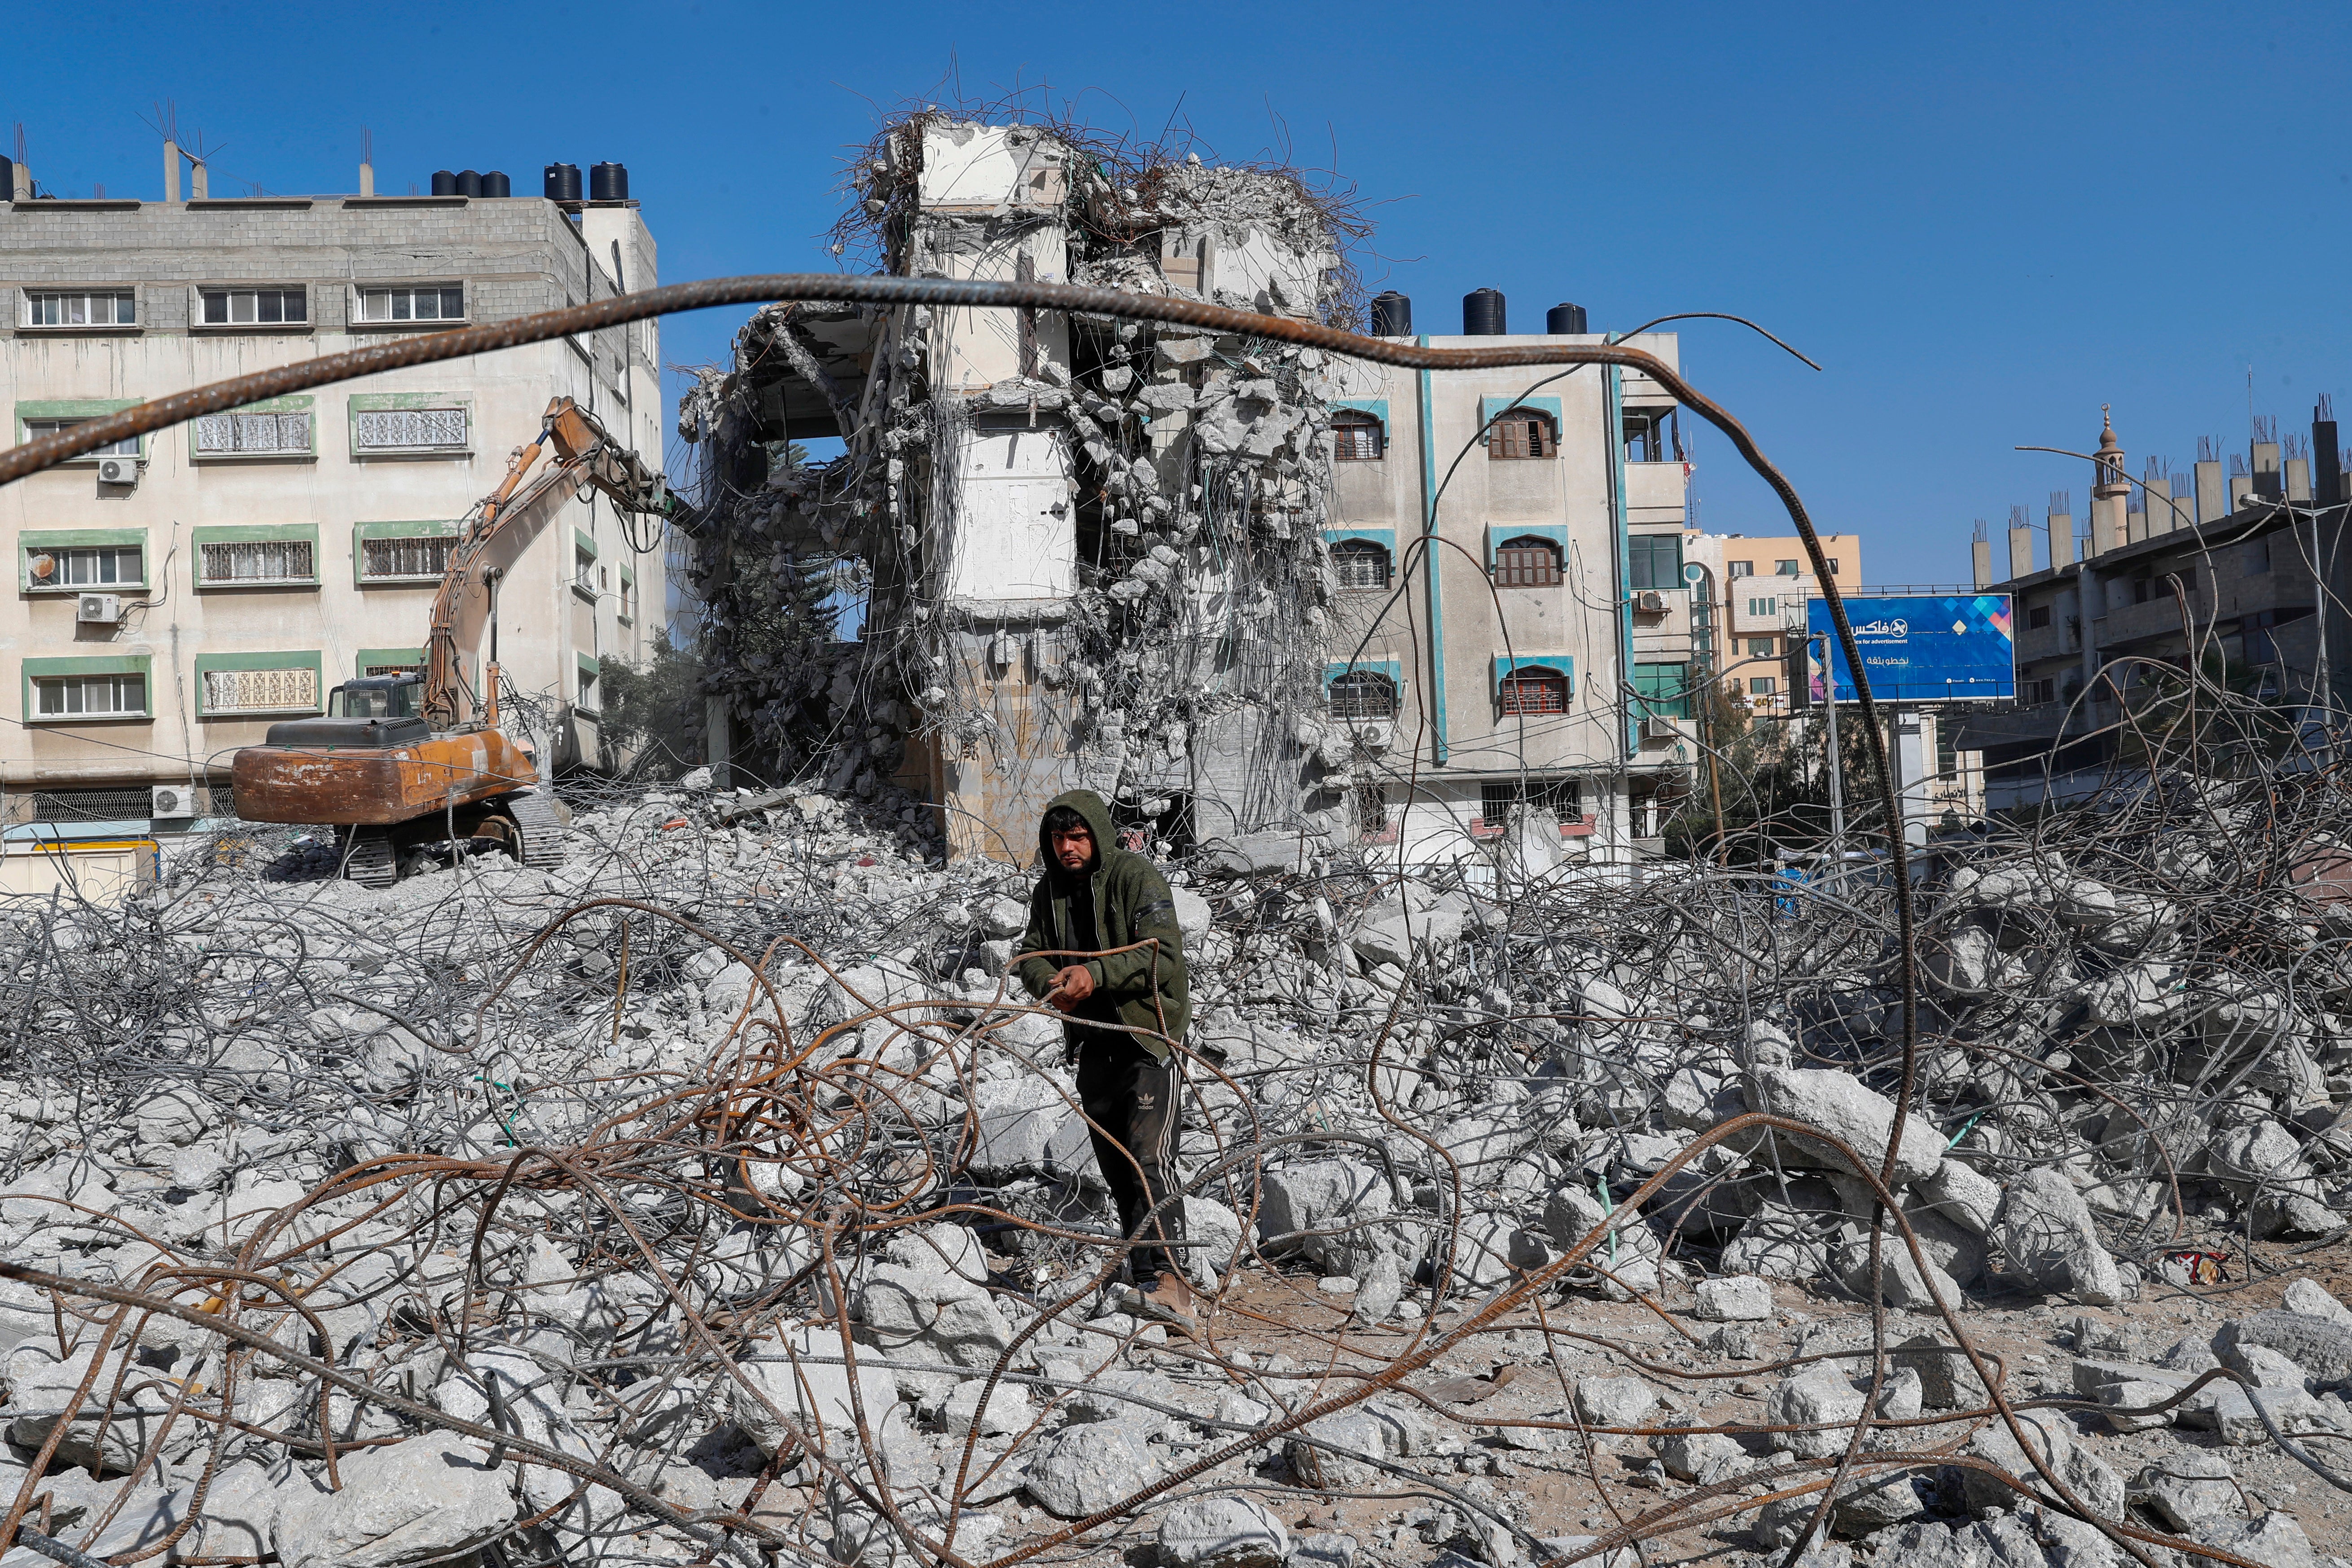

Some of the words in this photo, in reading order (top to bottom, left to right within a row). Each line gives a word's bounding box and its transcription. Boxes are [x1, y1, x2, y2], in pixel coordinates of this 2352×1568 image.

[1851, 620, 1889, 636] فلكس
[1866, 656, 1884, 666] بثقة
[1886, 657, 1909, 666] نخطو
[1176, 1233, 1186, 1268] adids
